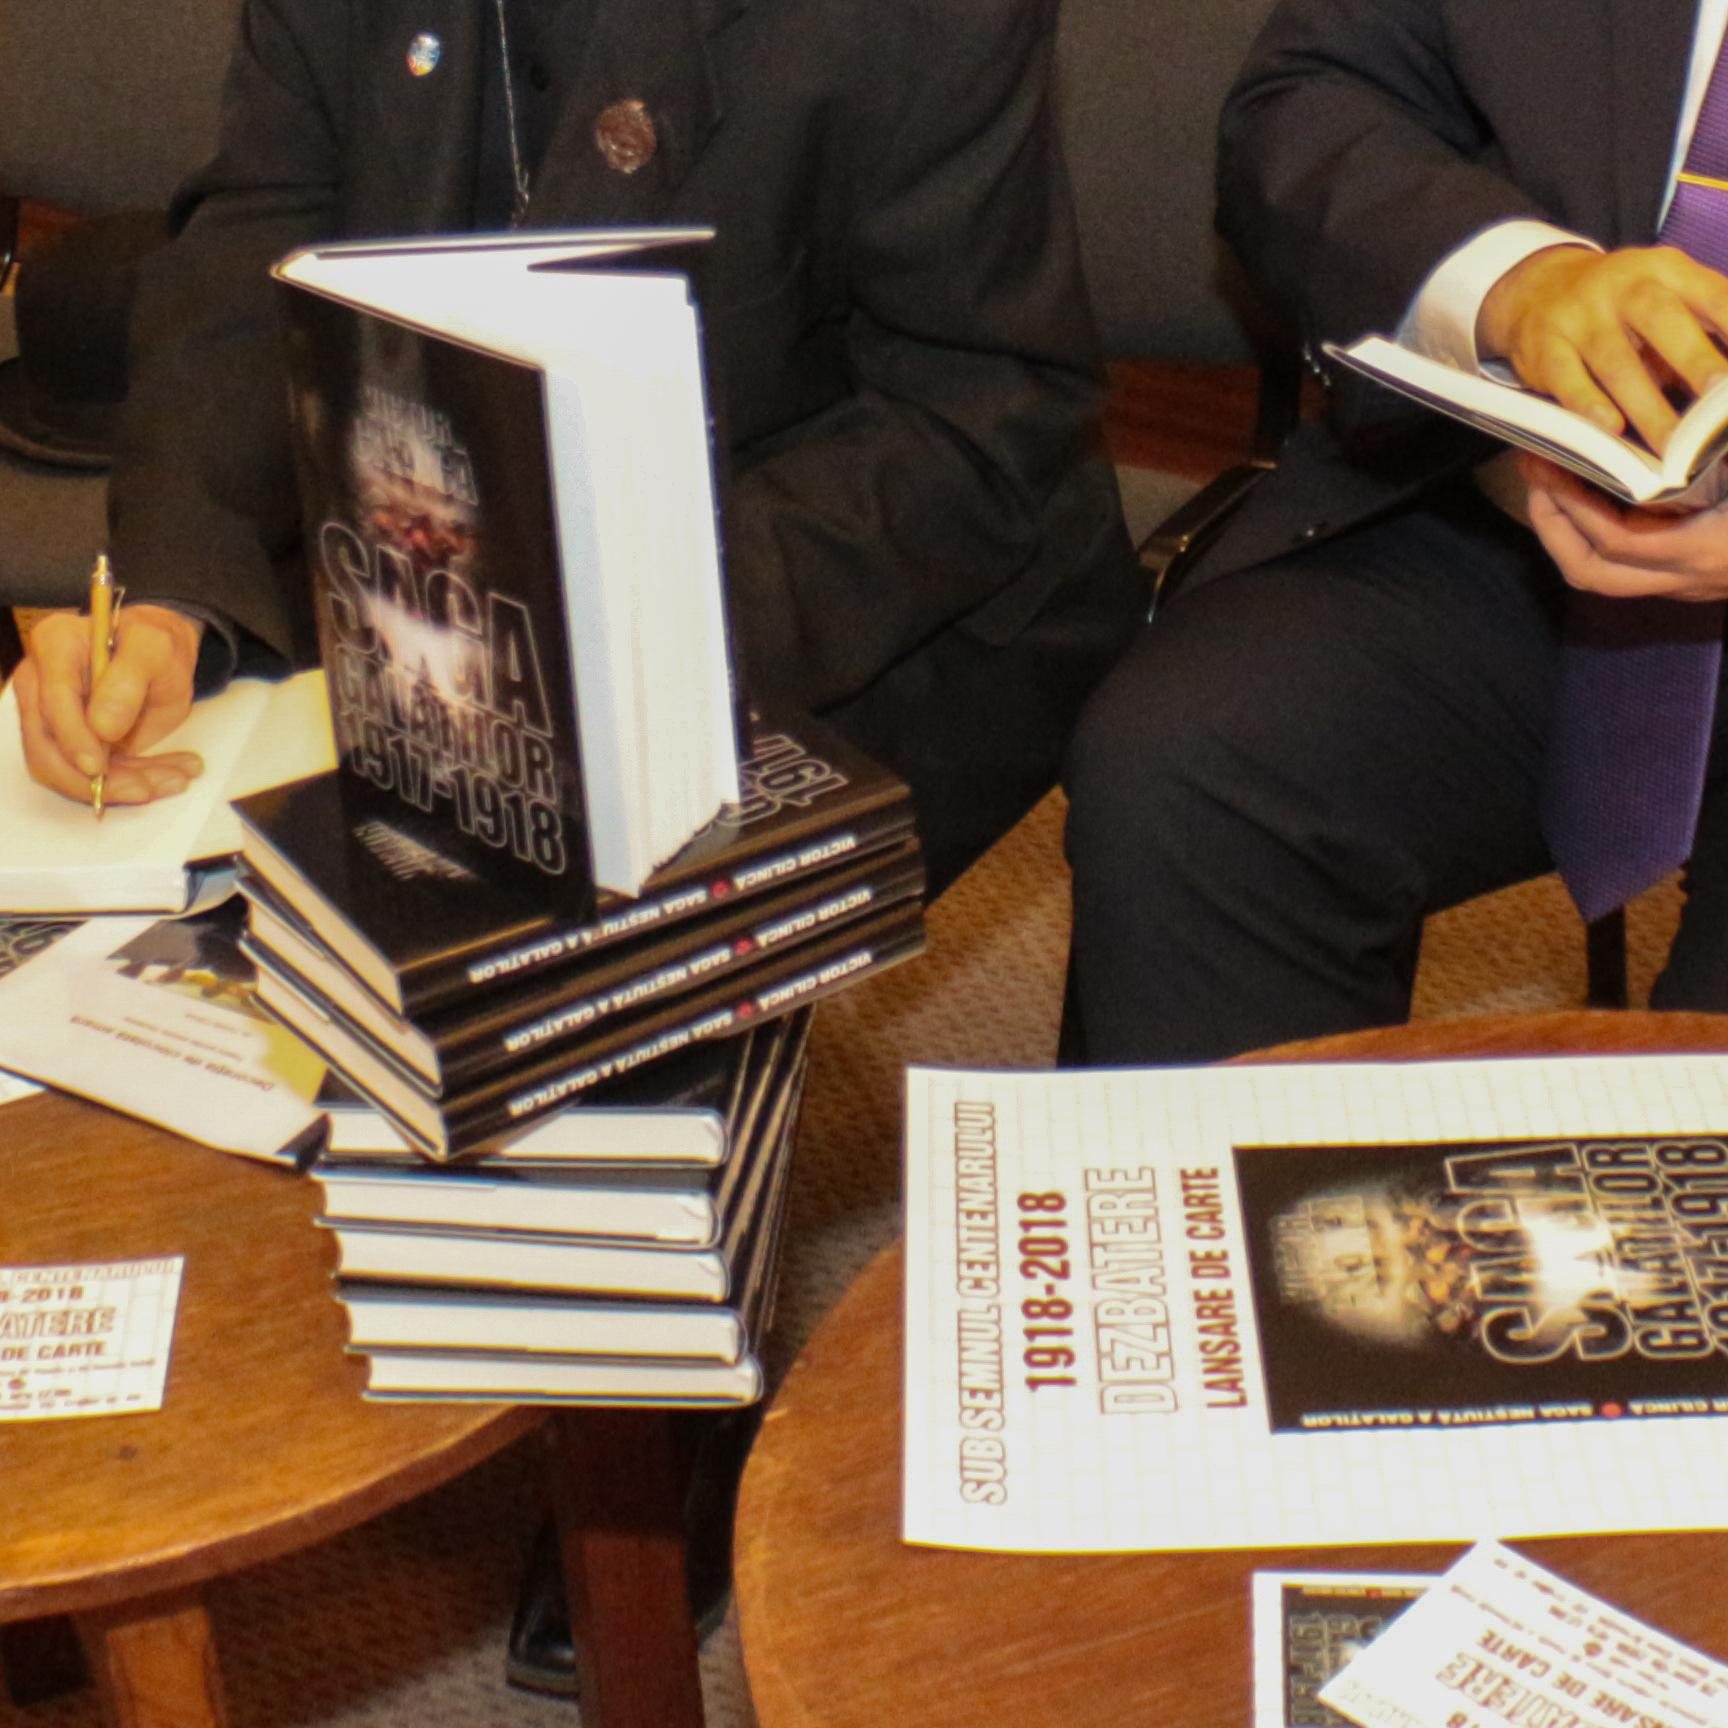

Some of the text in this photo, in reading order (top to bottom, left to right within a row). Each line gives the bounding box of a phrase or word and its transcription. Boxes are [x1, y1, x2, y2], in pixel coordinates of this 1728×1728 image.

[321, 522, 553, 738] SAGA
[341, 704, 566, 874] 1917-1918
[799, 834, 857, 867] VICTOR
[663, 889, 708, 915] SAGA
[818, 888, 872, 922] VICTOR
[564, 933, 579, 950] A
[689, 947, 732, 975] SAGA
[818, 951, 872, 985] VICTOR
[595, 999, 611, 1015] A
[692, 1010, 735, 1039] SAGA
[599, 1063, 615, 1079] A
[1444, 1142, 1637, 1363] SAGA
[954, 1101, 1007, 1506] SUB SEMNUL CENTENARULUI
[1017, 1191, 1077, 1391] 1918-2018
[1083, 1166, 1179, 1415] DEZBATERE
[1179, 1167, 1247, 1408] LANSARE DE CARTE
[0, 1345, 27, 1362] DE
[37, 1341, 107, 1361] CARTE
[1418, 1411, 1432, 1425] A
[1540, 1402, 1593, 1419] SAGA
[1475, 1629, 1552, 1679] CARTE
